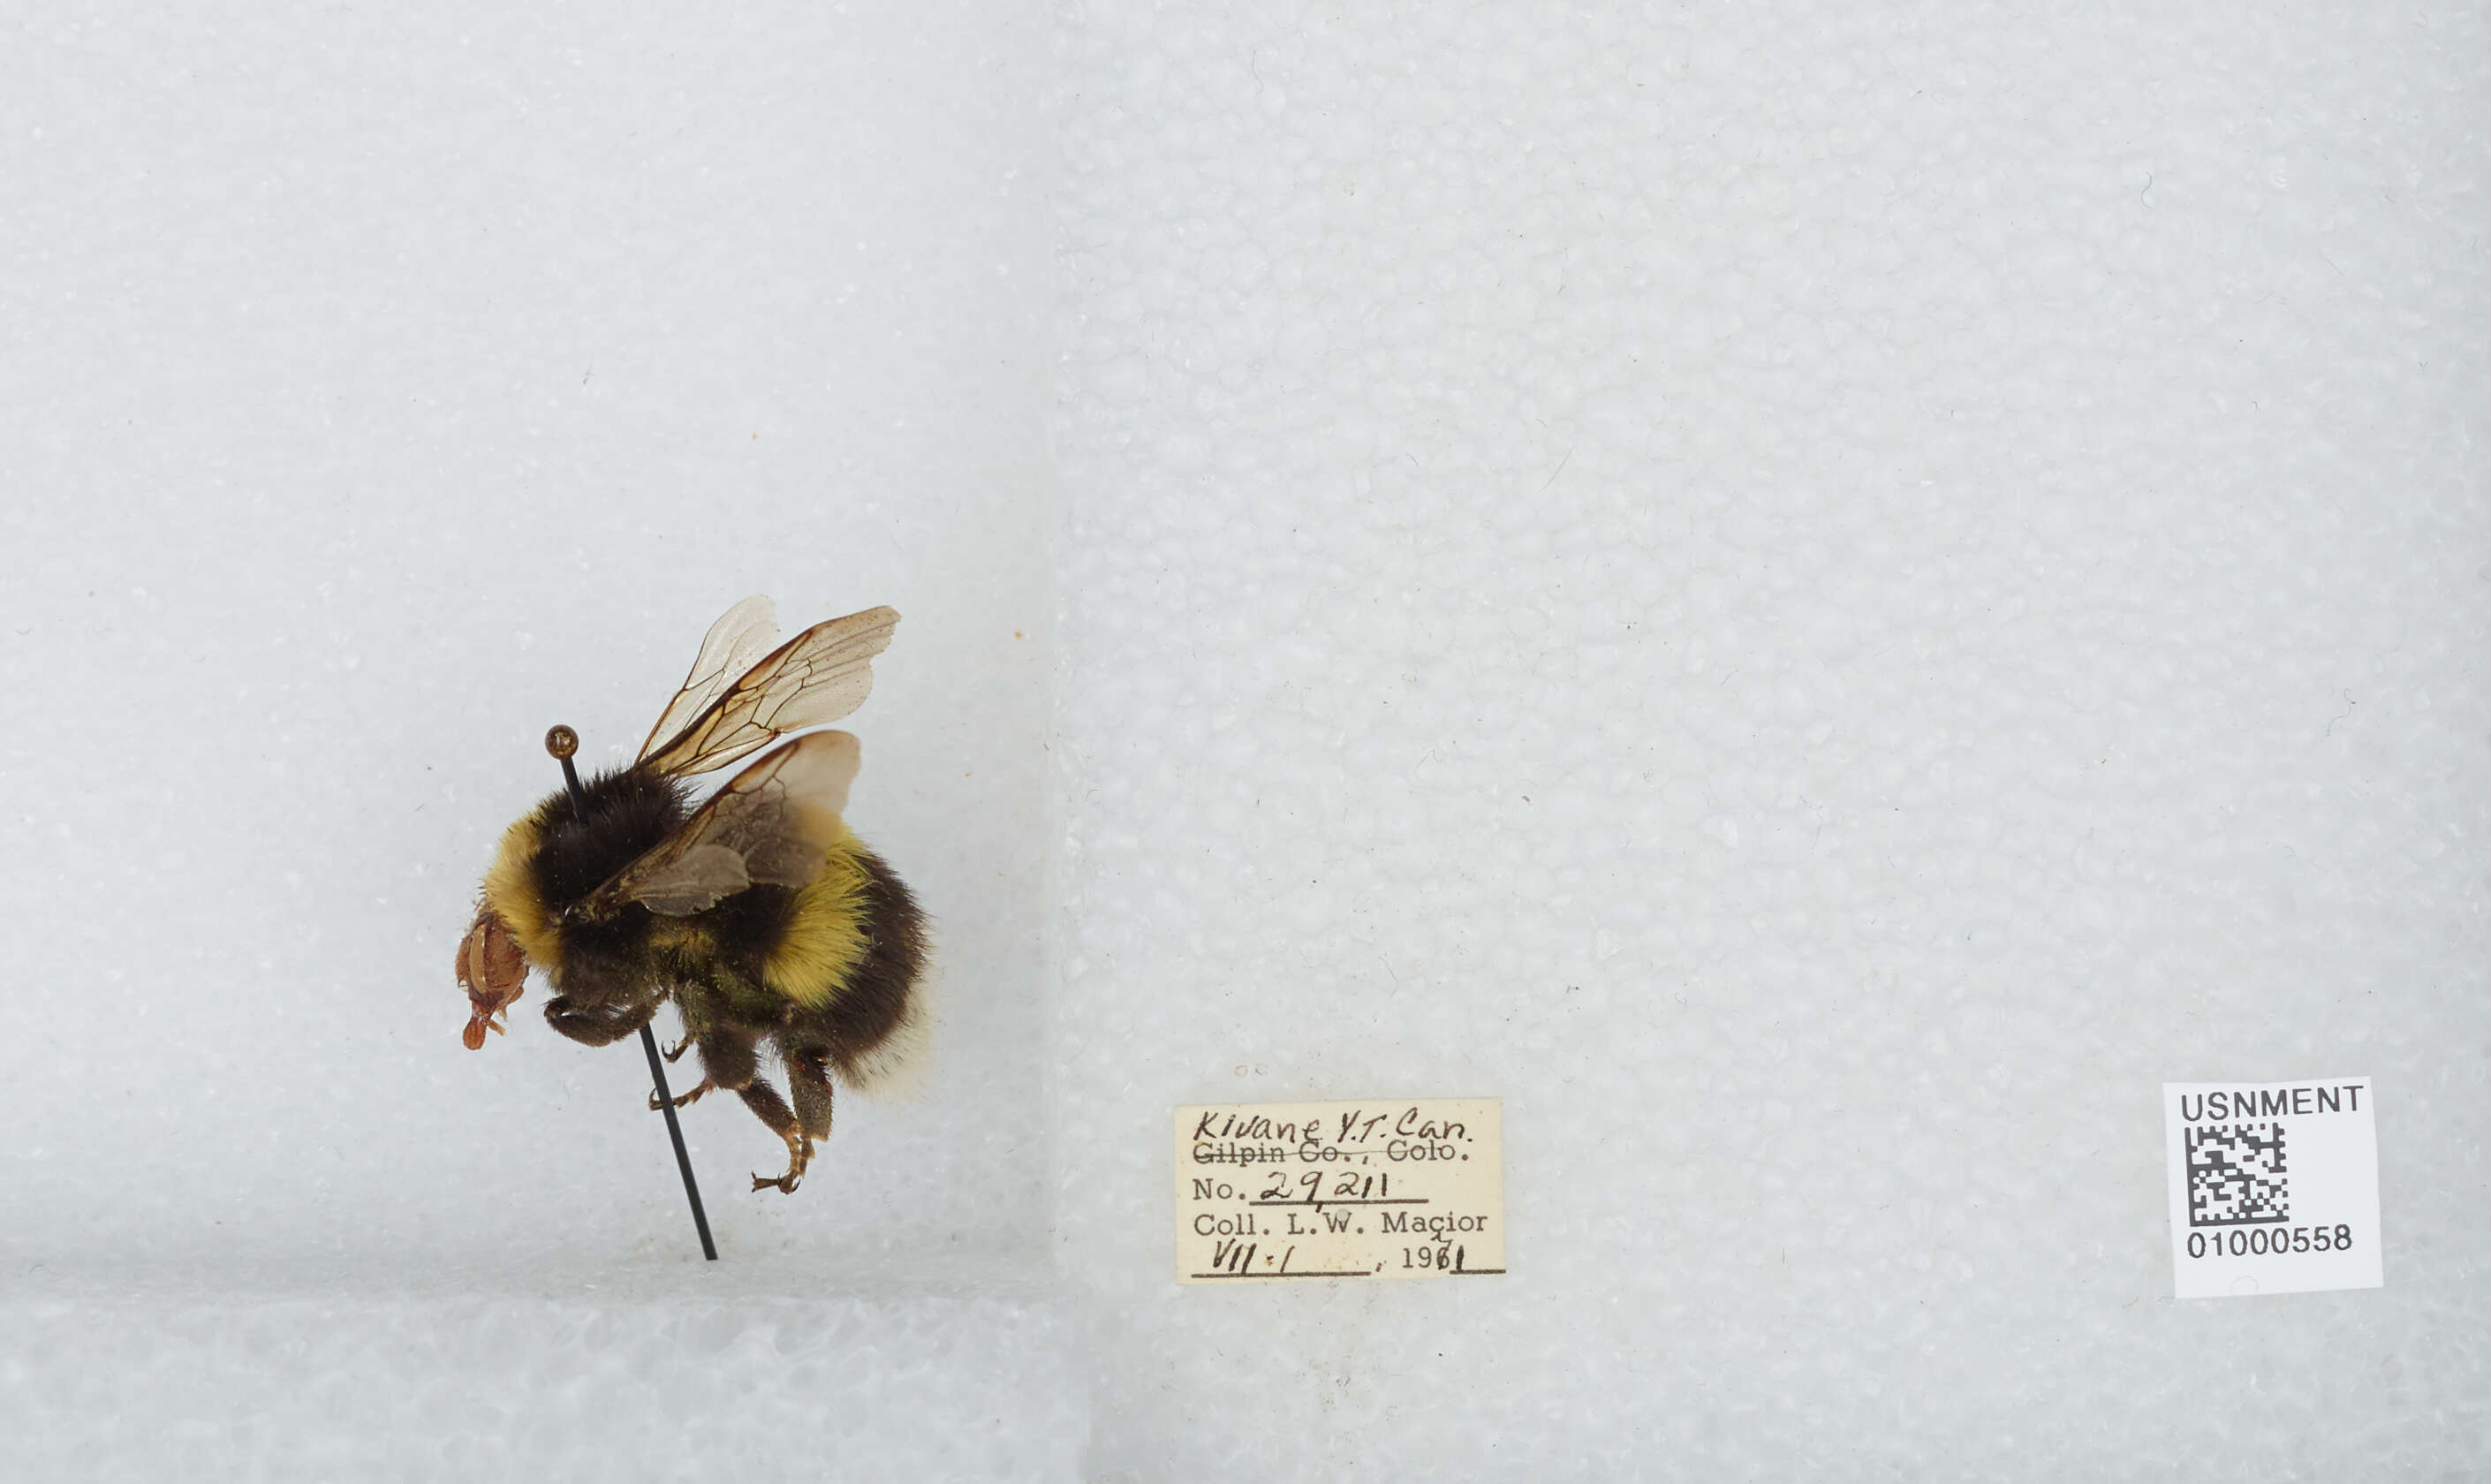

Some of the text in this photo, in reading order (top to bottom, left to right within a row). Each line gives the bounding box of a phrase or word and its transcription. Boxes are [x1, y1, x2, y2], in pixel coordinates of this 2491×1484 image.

[2181, 1086, 2365, 1122] USNMENT
[1396, 1107, 1473, 1142] Can.
[1193, 1140, 1286, 1167] Gilpin
[1387, 1139, 1470, 1162] Colo.
[1192, 1177, 1246, 1201] No.
[1193, 1214, 1270, 1237] Coll.
[2187, 1223, 2352, 1258] 01000558
